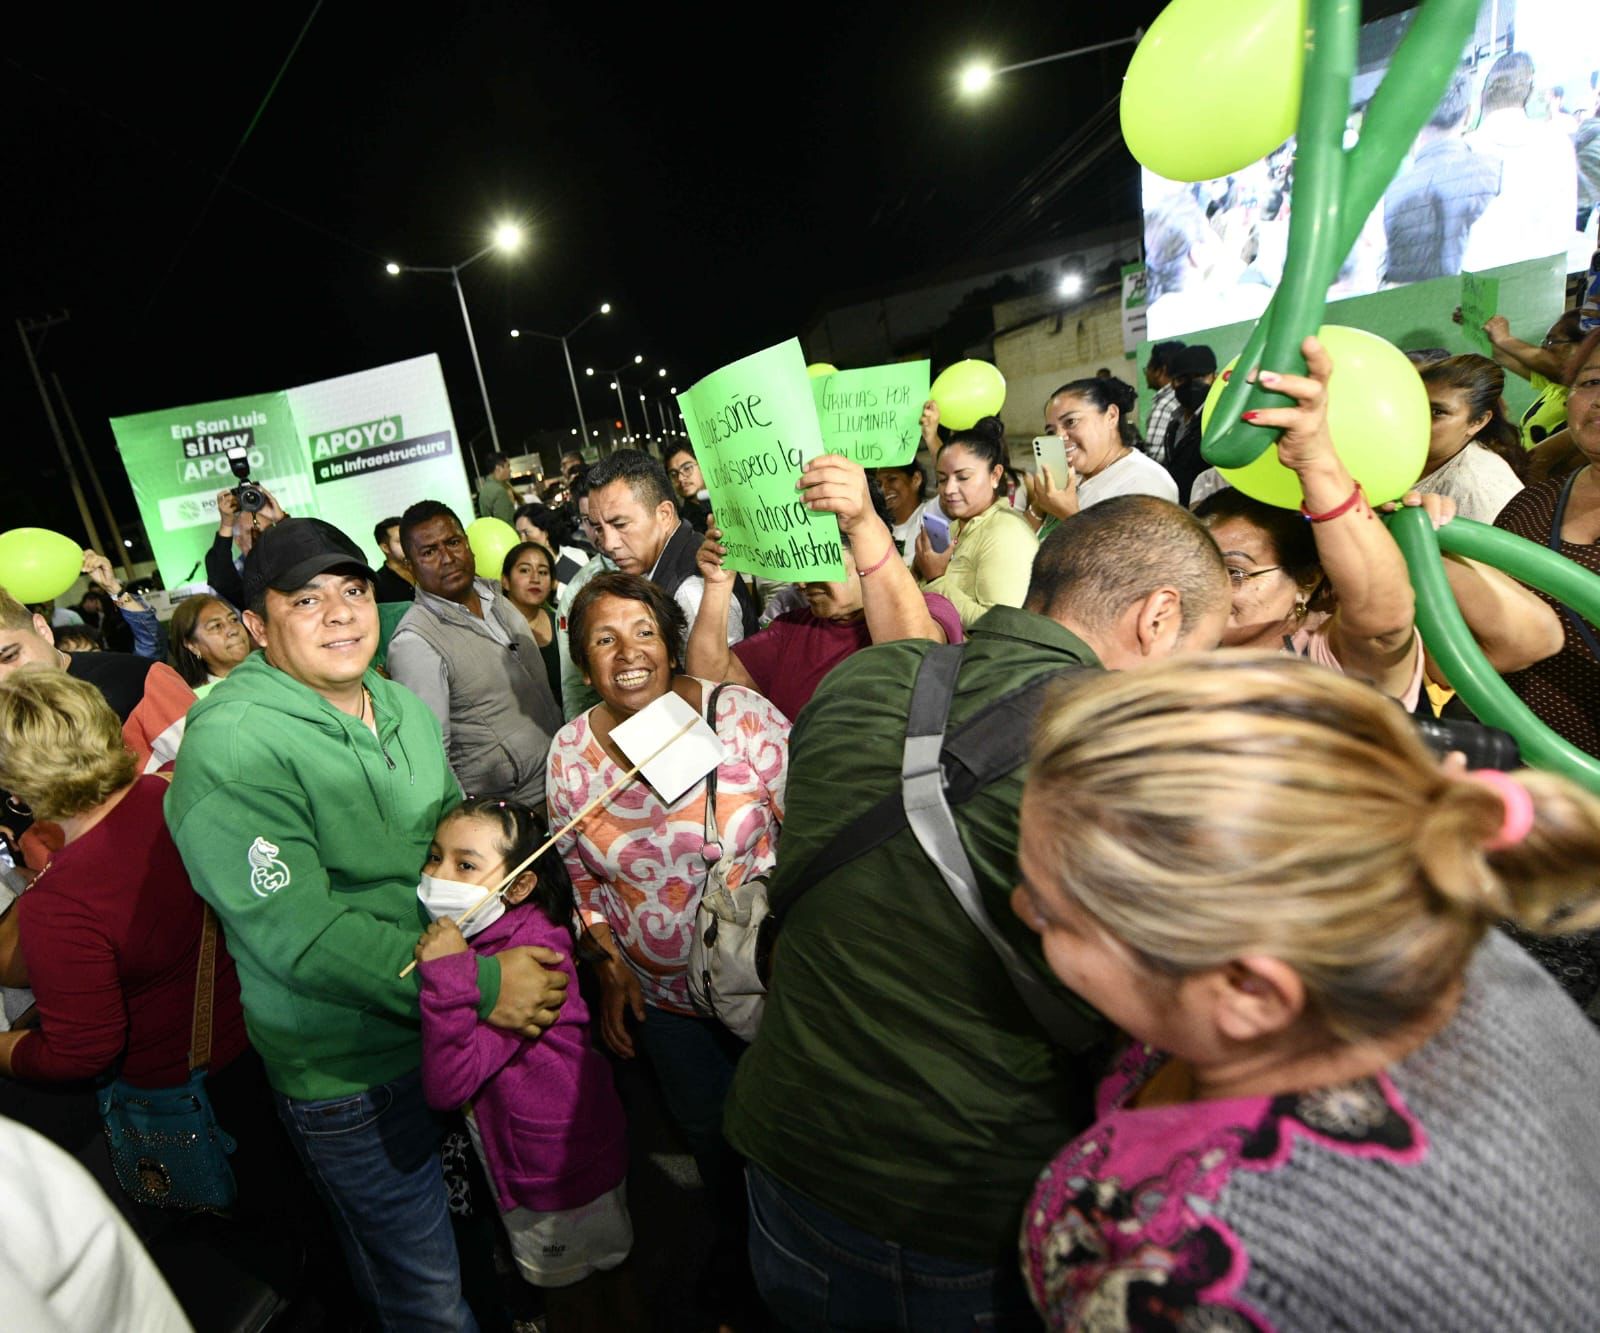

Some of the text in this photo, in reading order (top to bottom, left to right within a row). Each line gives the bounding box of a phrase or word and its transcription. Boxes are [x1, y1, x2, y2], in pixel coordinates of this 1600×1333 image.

[171, 410, 268, 439] En San Luis
[183, 449, 265, 482] APOO
[320, 440, 446, 479] a la Infraestructura
[855, 440, 883, 461] LUIS
[756, 494, 812, 533] ahora
